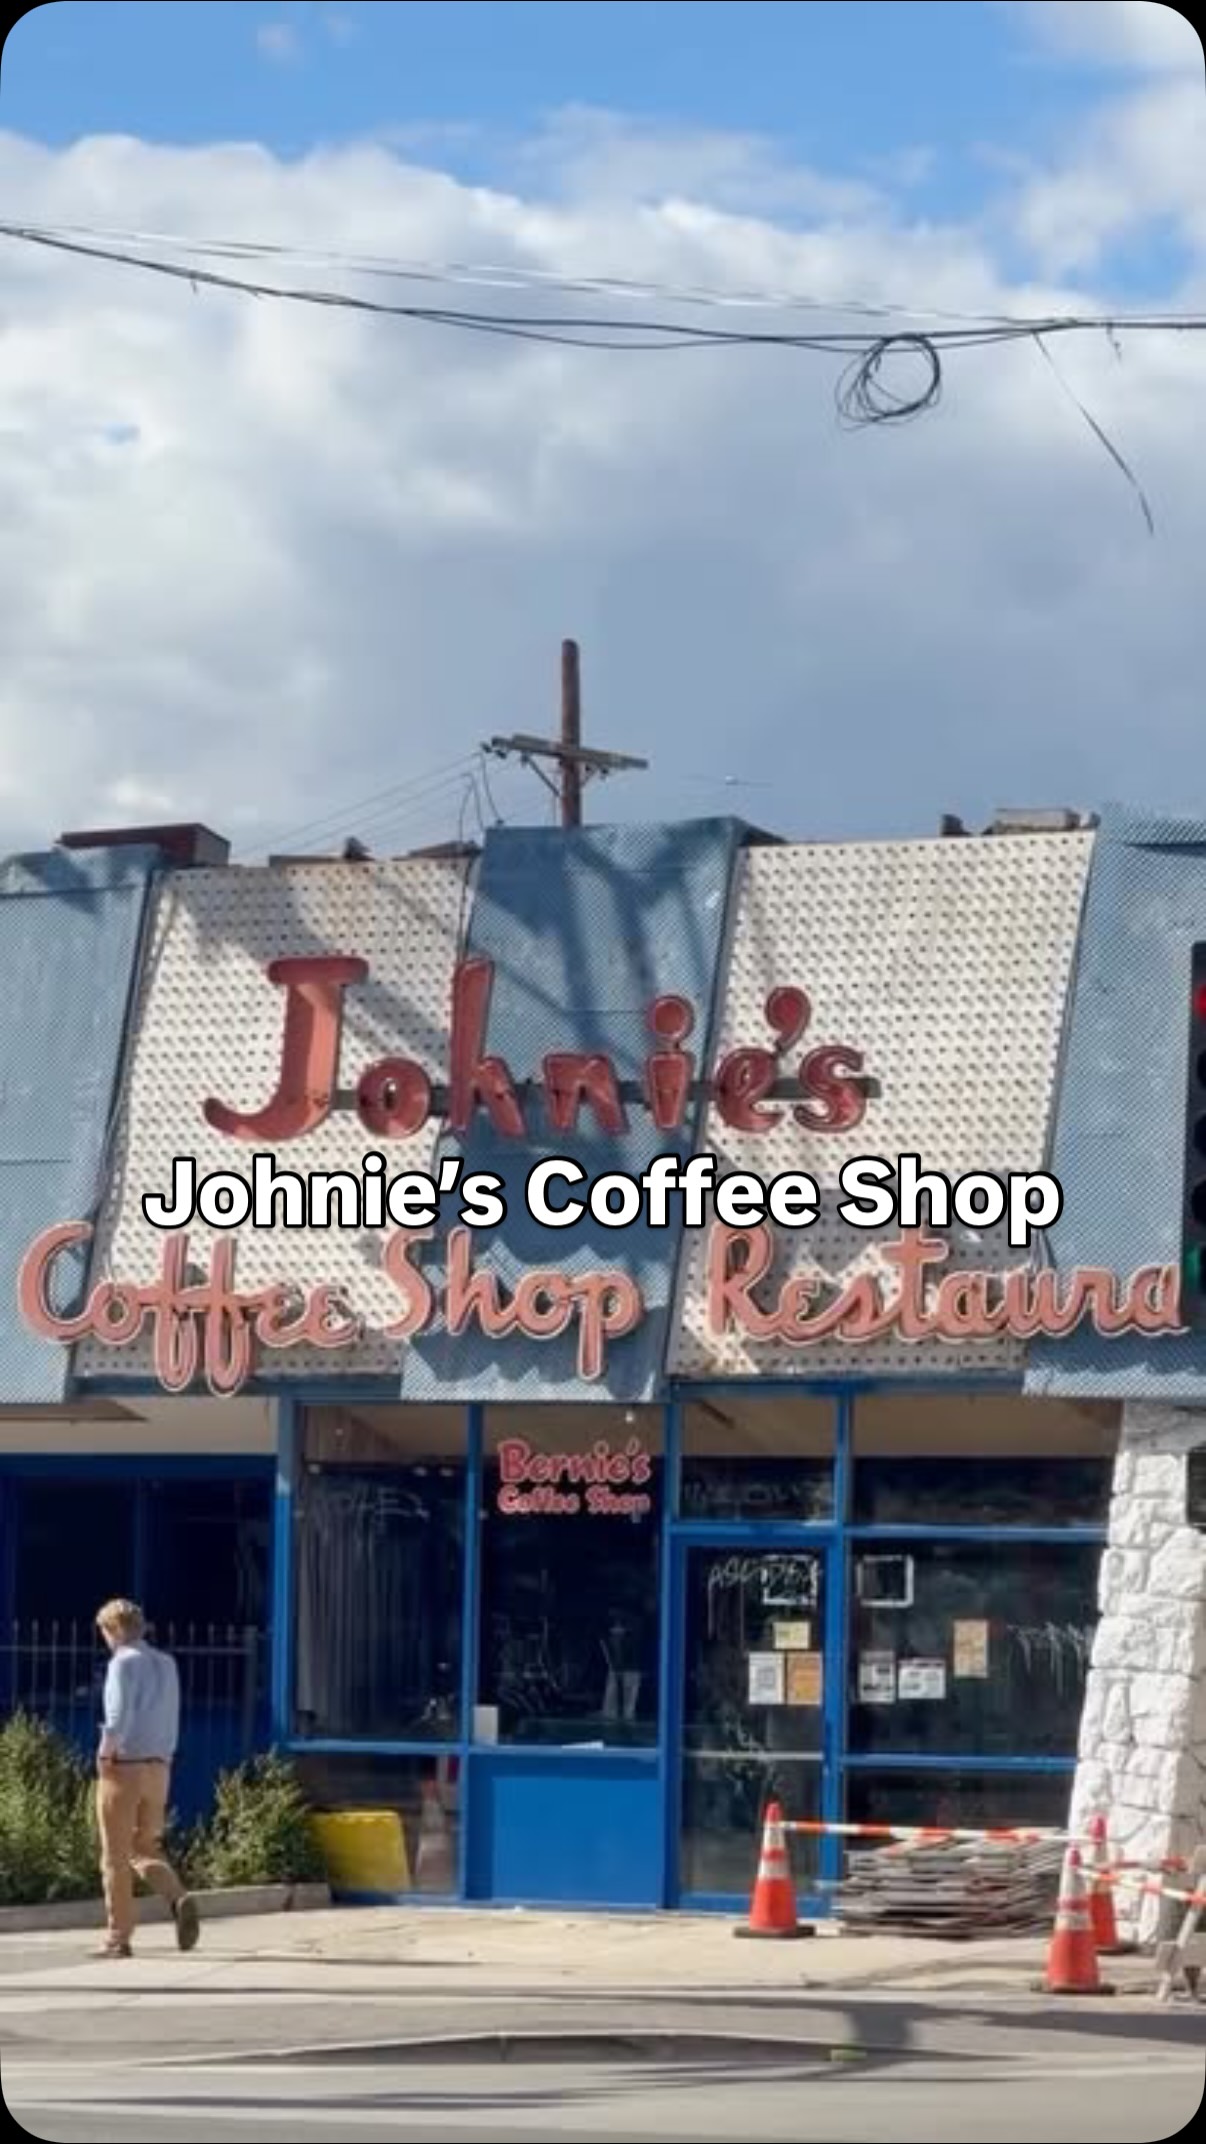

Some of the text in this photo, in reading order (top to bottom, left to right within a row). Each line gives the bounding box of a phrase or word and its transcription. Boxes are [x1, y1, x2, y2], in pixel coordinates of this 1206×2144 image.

[203, 956, 868, 1140] Johnie's
[17, 1220, 358, 1396] Coffee
[382, 1226, 642, 1379] Shop
[498, 1438, 651, 1483] Bernie's
